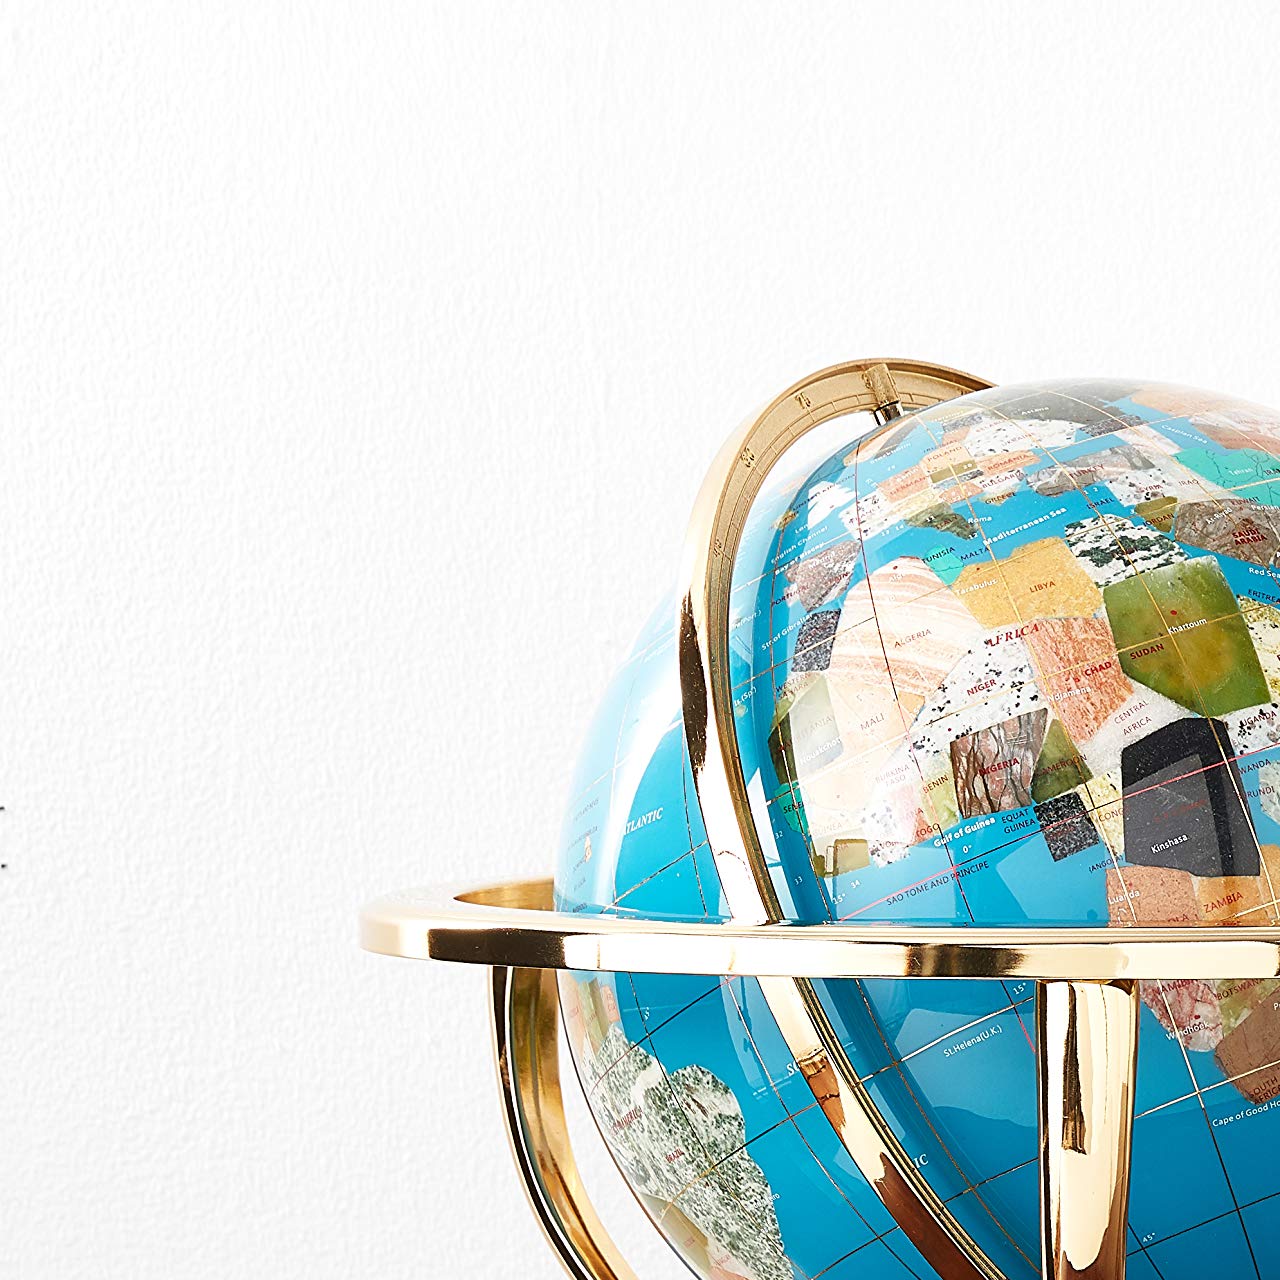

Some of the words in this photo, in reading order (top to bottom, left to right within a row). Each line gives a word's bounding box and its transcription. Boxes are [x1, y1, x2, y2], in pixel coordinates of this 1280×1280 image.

[968, 515, 992, 524] Roma
[983, 514, 1050, 546] Mediterranean
[1050, 507, 1067, 520] Sea
[797, 526, 828, 546] Channel
[1232, 528, 1260, 539] SAUDI
[1234, 534, 1267, 546] ARABIA
[921, 547, 956, 564] TUNISIA
[960, 546, 991, 562] MALTA
[1249, 567, 1265, 575] Red
[1266, 570, 1280, 579] Sea
[1029, 580, 1056, 593] LIBYA
[1248, 589, 1280, 604] ERITREA
[985, 623, 1040, 647] AFRICA
[1168, 618, 1208, 635] Khartoum
[894, 629, 932, 648] ALGERIA
[1130, 644, 1164, 660] SUDAN
[1084, 661, 1112, 676] CHAD
[967, 679, 997, 696] NIGER
[1114, 700, 1149, 725] CENTRAL
[1242, 711, 1277, 726] UGANDA
[860, 713, 885, 731] MALI
[1123, 716, 1152, 735] AFRICA
[979, 757, 1020, 776] NIGERIA
[1239, 758, 1272, 774] WANDA
[923, 776, 949, 793] BENIN
[1001, 808, 1030, 823] EQUAT
[916, 823, 939, 838] TOGO
[933, 834, 953, 848] Gulf
[954, 828, 964, 839] of
[964, 816, 996, 834] Guinea
[1004, 818, 1036, 834] GUINEA
[1151, 833, 1189, 854] Kinshasa
[886, 892, 904, 906] SAO
[904, 885, 930, 898] TOME
[930, 876, 949, 889] AND
[951, 861, 990, 881] PRINCIPE
[1108, 889, 1141, 905] Luanda
[1203, 891, 1244, 913] ZAMBIA
[1013, 982, 1027, 995] 15°
[1165, 1021, 1209, 1041] Wndhoek
[1249, 1077, 1278, 1097] SOUTH
[1212, 1114, 1234, 1127] Cape
[1235, 1111, 1245, 1120] of
[1246, 1103, 1269, 1116] Good
